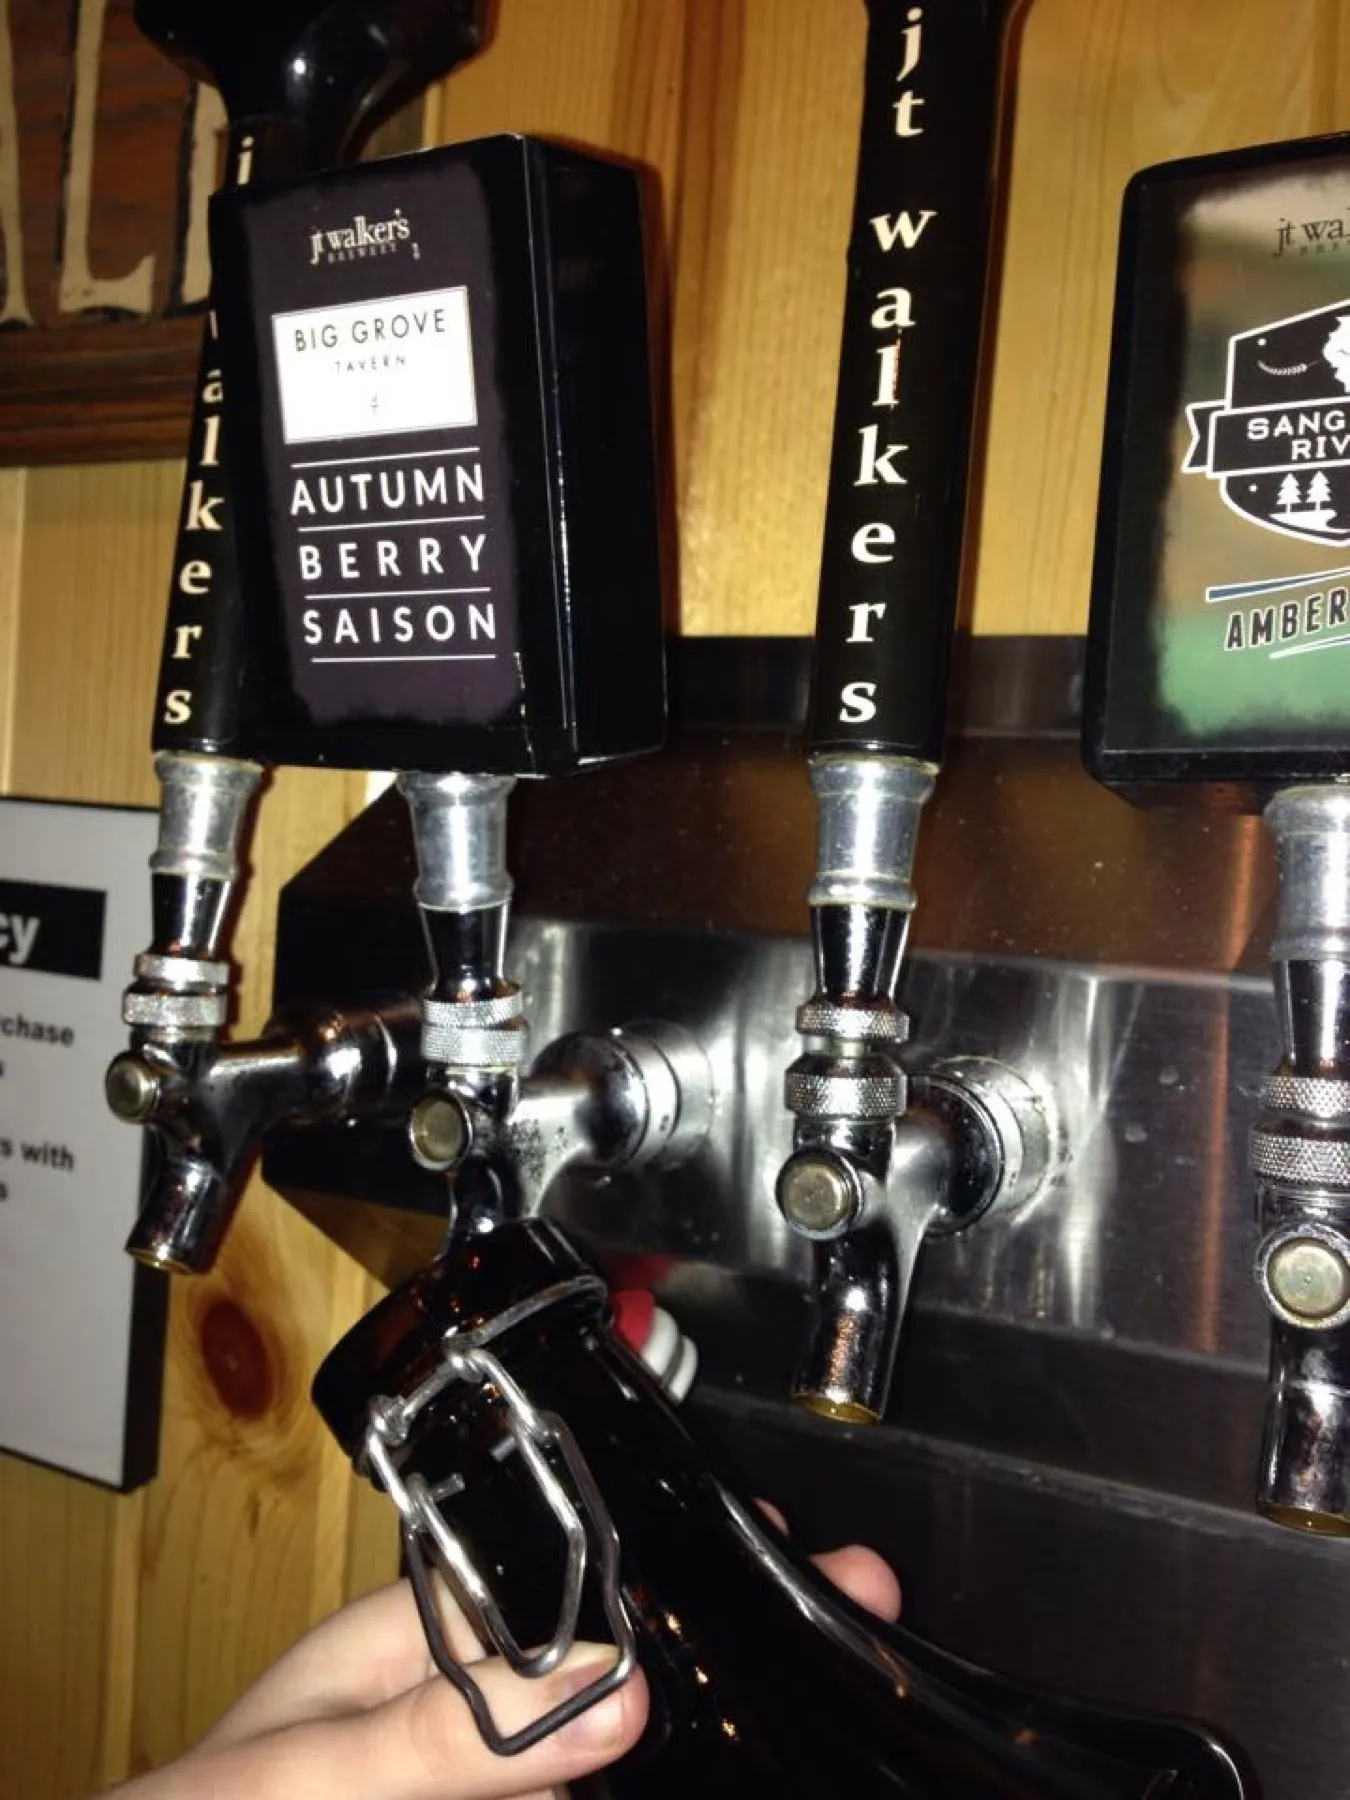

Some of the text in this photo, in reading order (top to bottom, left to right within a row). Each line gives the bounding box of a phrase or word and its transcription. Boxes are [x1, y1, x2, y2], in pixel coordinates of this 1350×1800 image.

[1271, 217, 1298, 259] jt
[1300, 207, 1350, 241] wa
[294, 308, 447, 353] BIG GROVE
[333, 353, 406, 375] TAVERN
[839, 8, 937, 725] jt walkers
[290, 462, 485, 517] AUTUMN
[164, 310, 225, 726] alkers
[299, 533, 487, 581] BERRY
[302, 603, 497, 646] SAISON
[1223, 586, 1350, 652] AMBER
[20, 1139, 76, 1173] with
